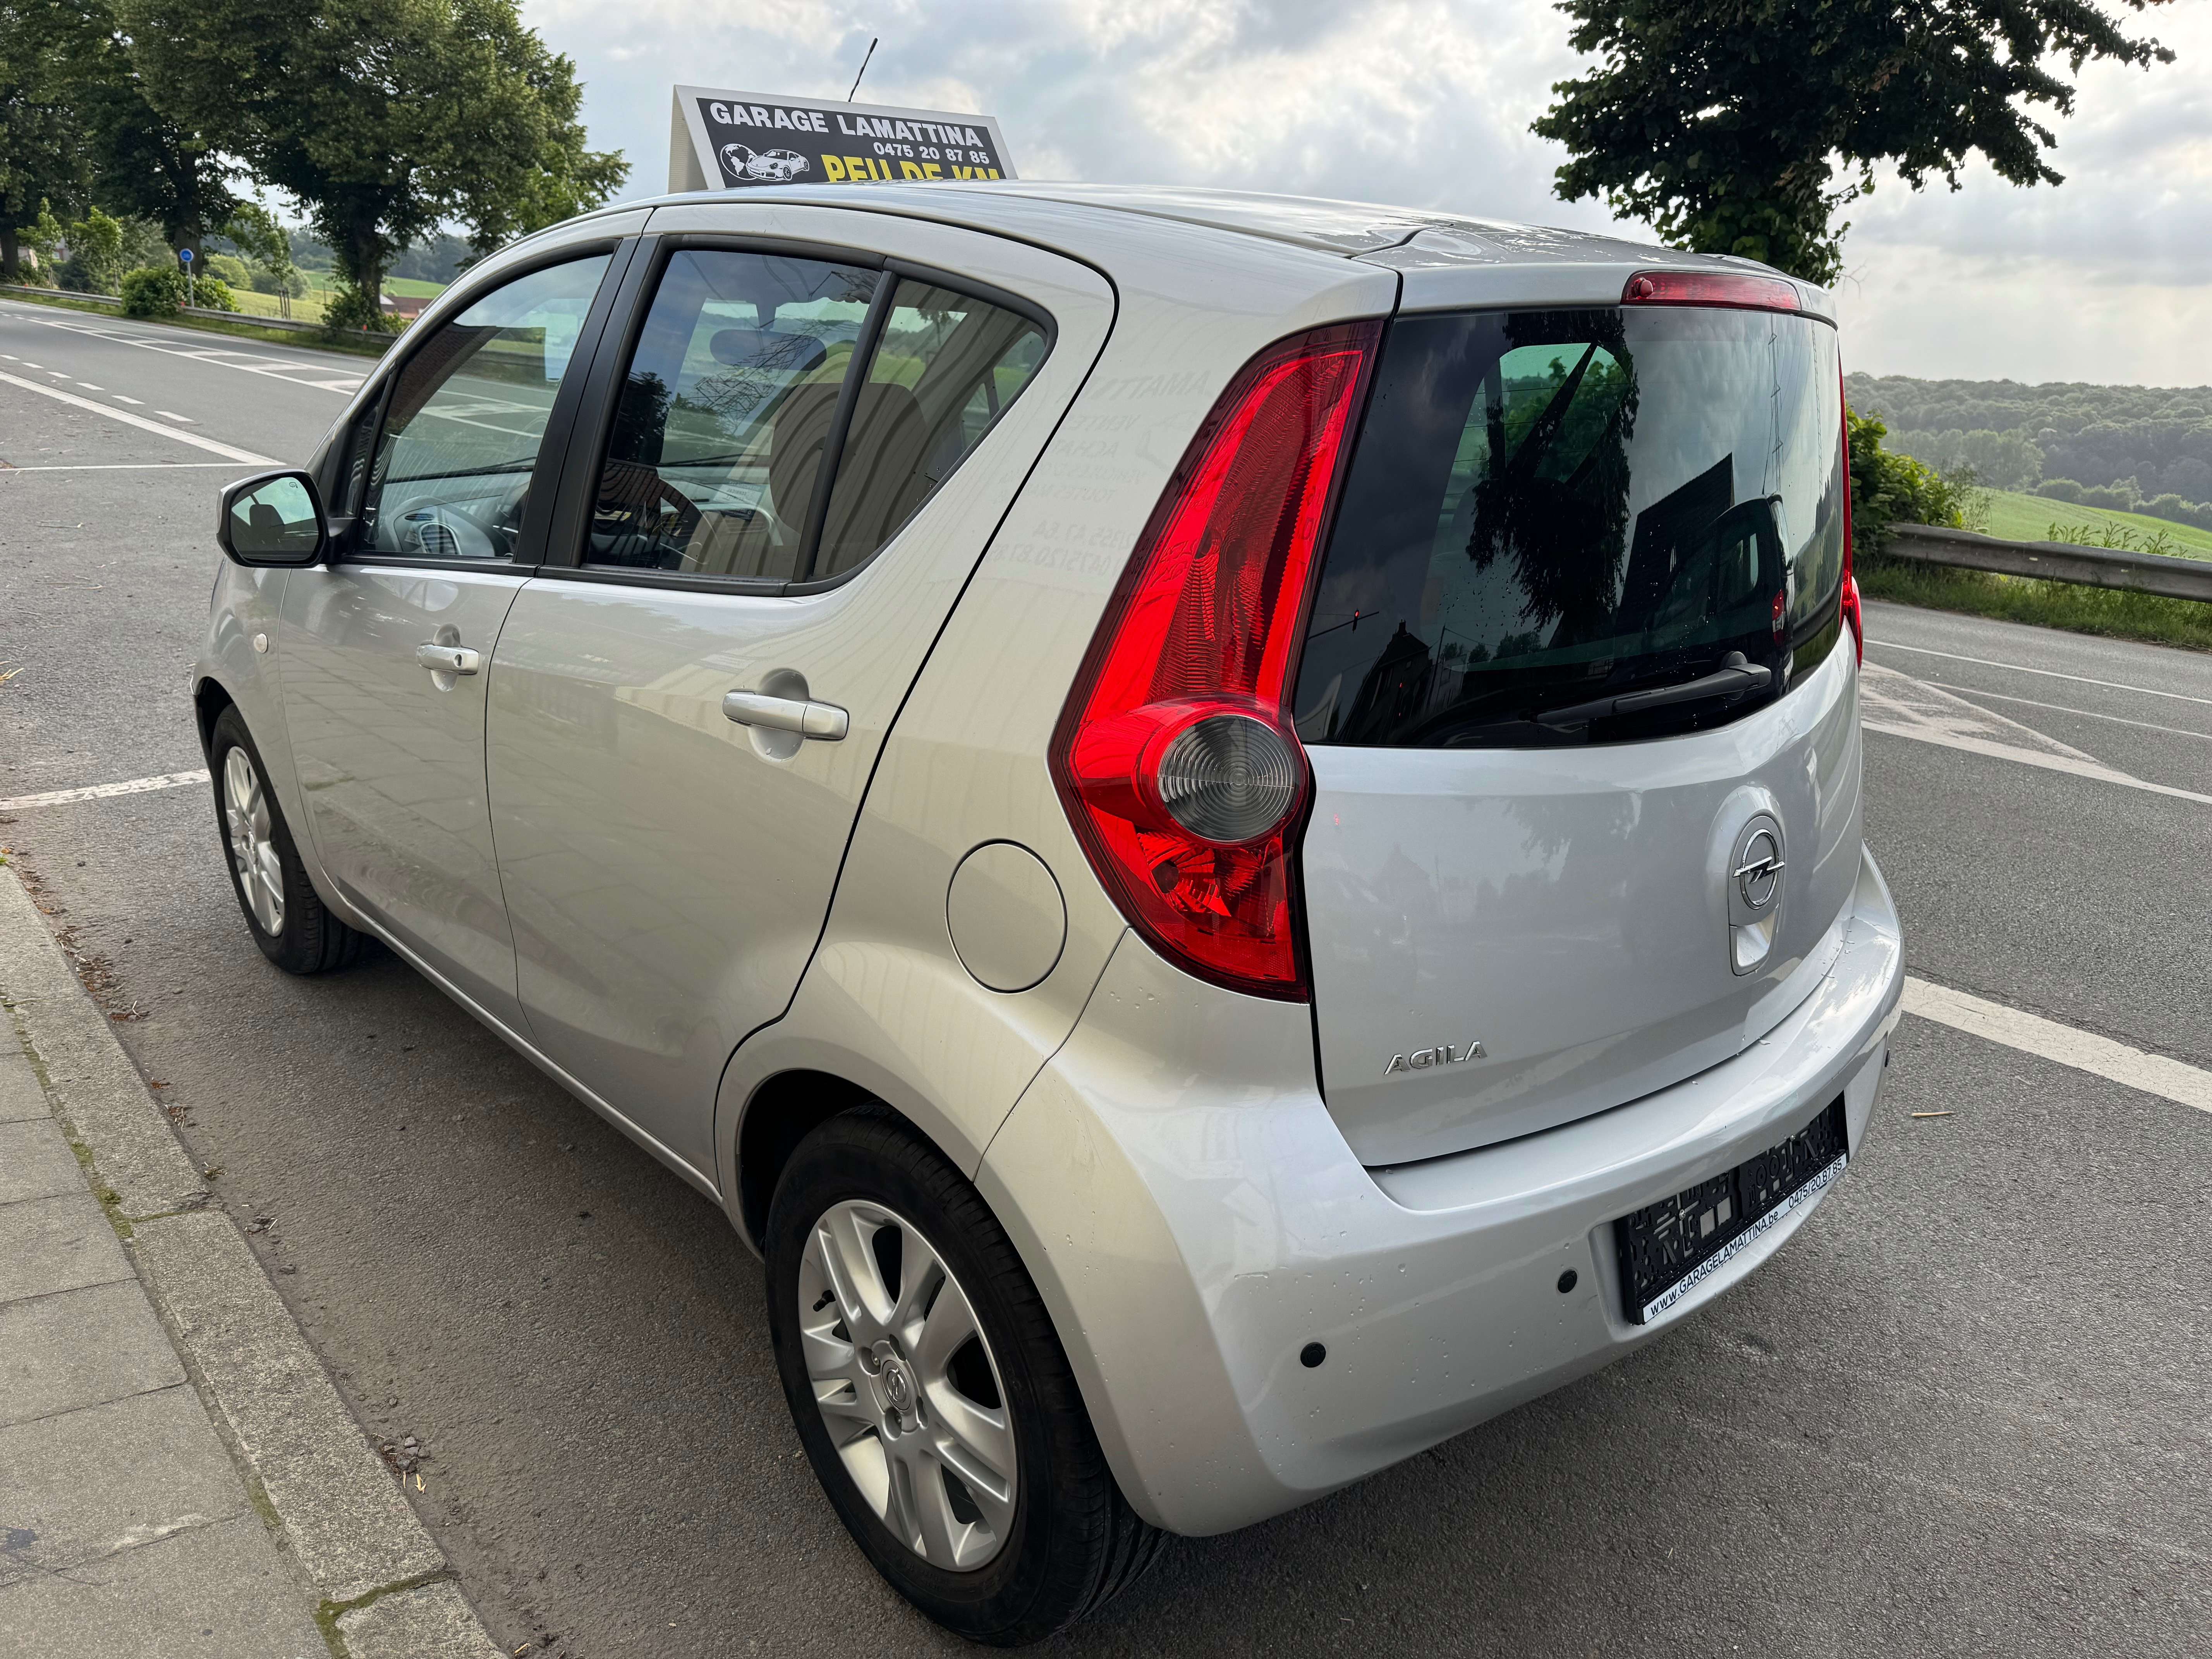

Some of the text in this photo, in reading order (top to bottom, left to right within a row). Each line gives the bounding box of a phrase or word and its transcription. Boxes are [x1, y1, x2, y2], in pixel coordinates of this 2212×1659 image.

[710, 102, 984, 147] GARAGE LAMATTINA
[873, 142, 989, 164] 0475 20 87 85
[1384, 1041, 1487, 1075] AGILA
[1650, 1158, 1842, 1316] www.GARAGELAMATTINA.be 0475/20.87.85
